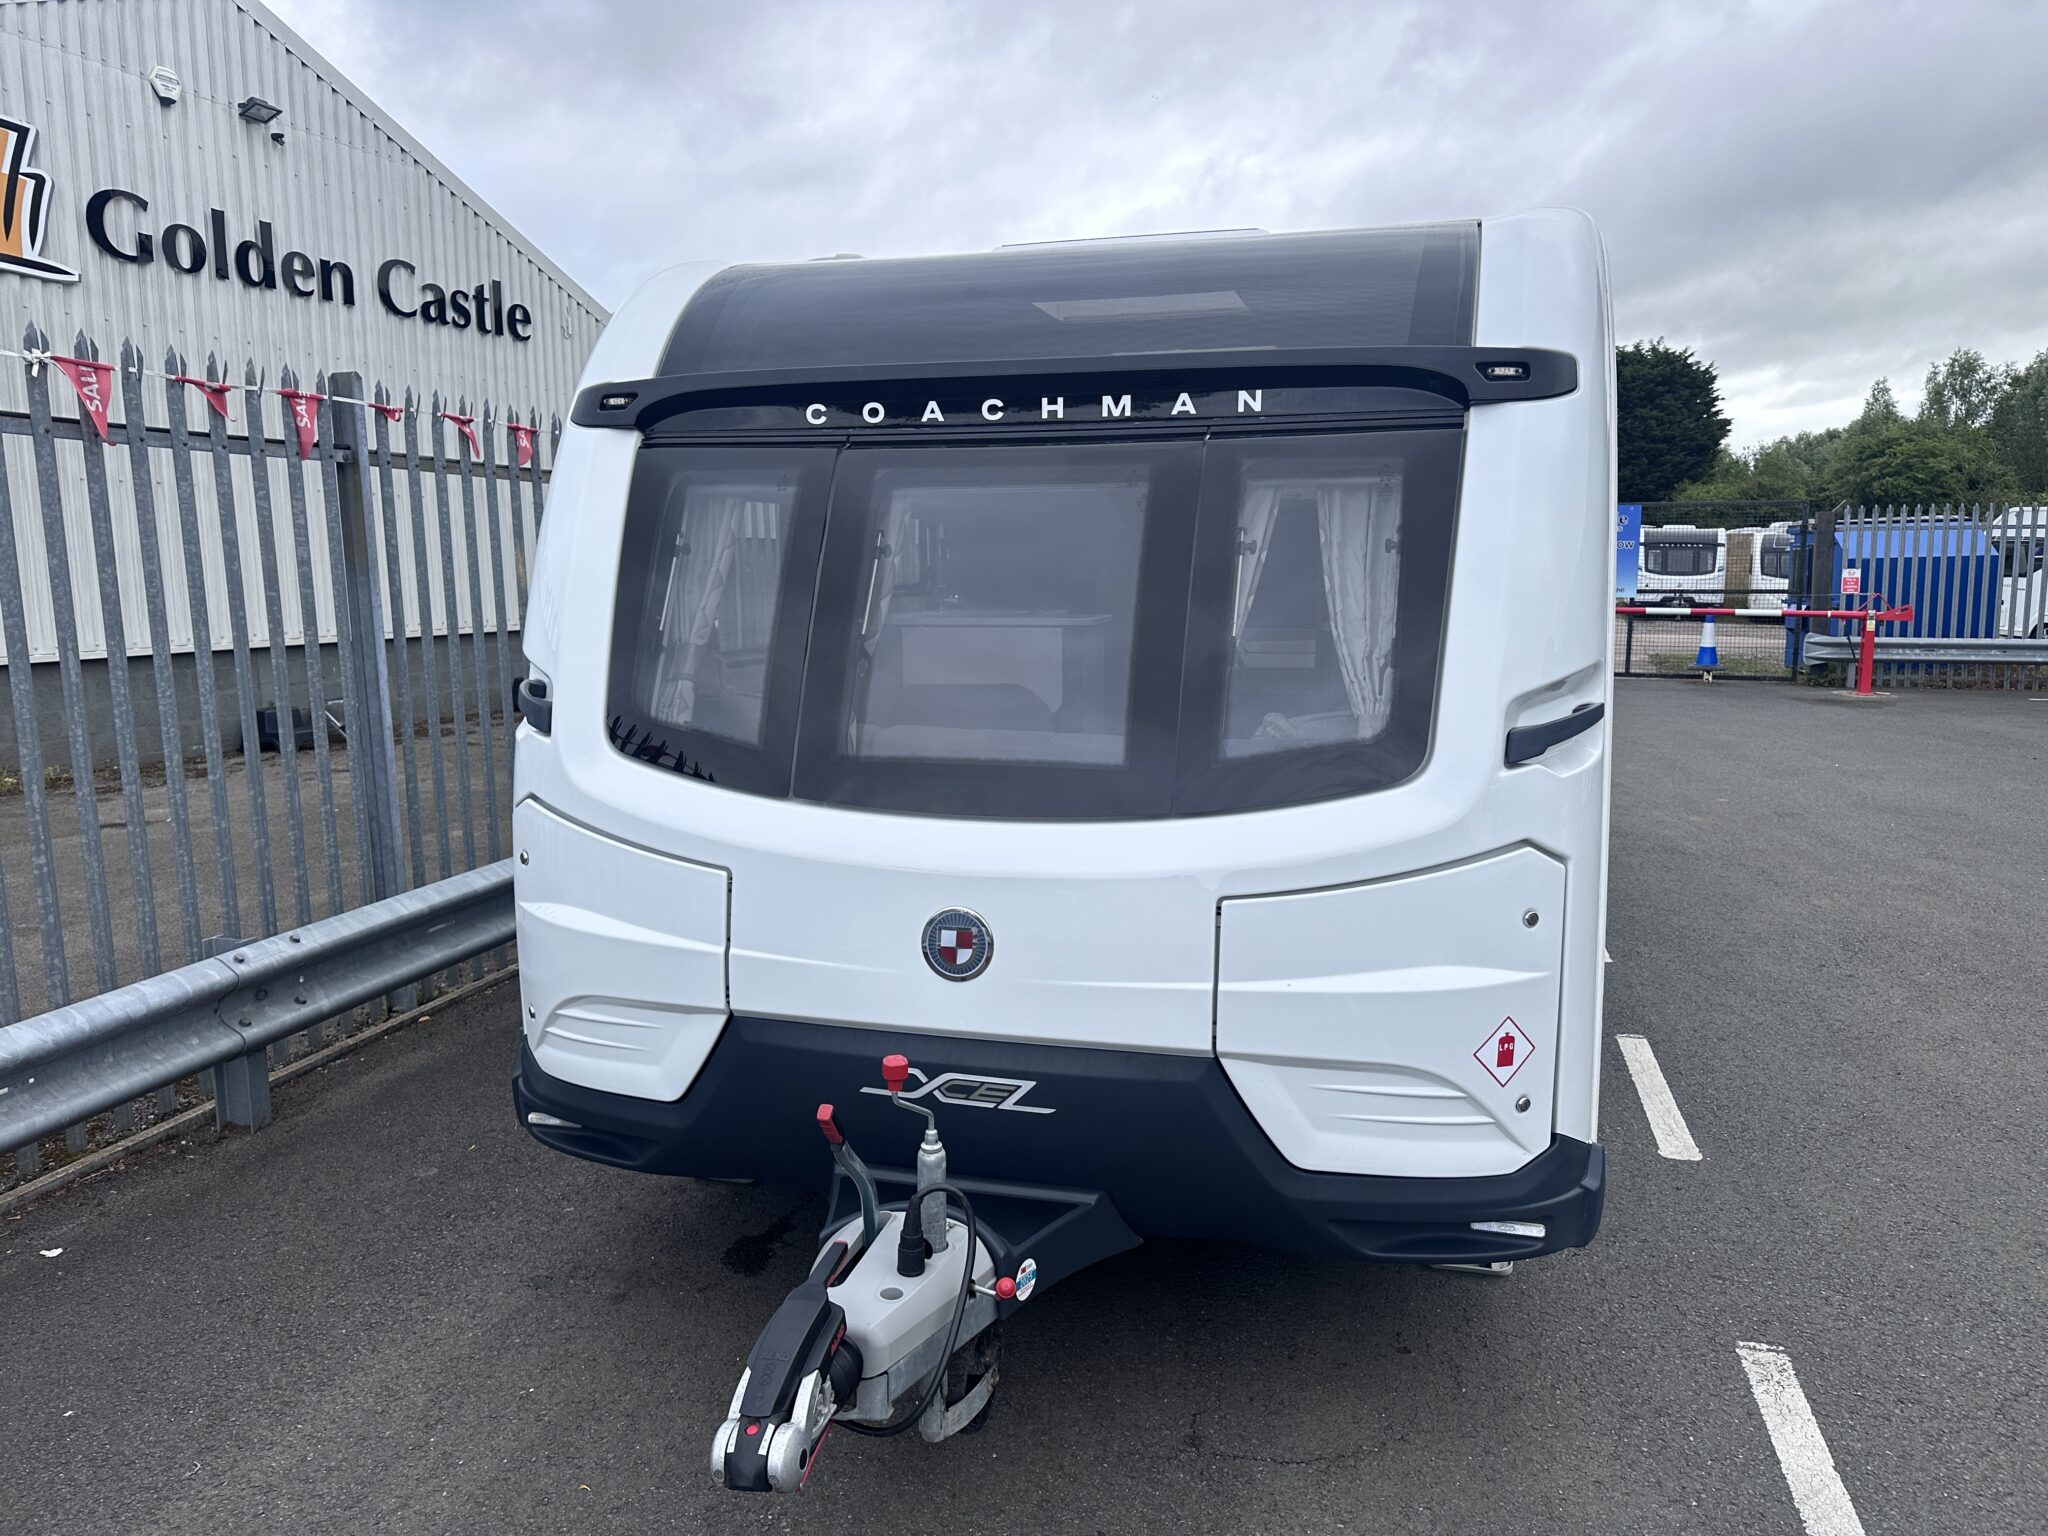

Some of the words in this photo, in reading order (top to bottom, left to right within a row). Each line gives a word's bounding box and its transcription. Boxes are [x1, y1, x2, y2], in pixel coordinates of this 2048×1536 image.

[86, 188, 355, 306] Golden
[377, 258, 533, 342] Castle
[805, 388, 1265, 426] COACHMAN
[1499, 1043, 1514, 1051] LPG
